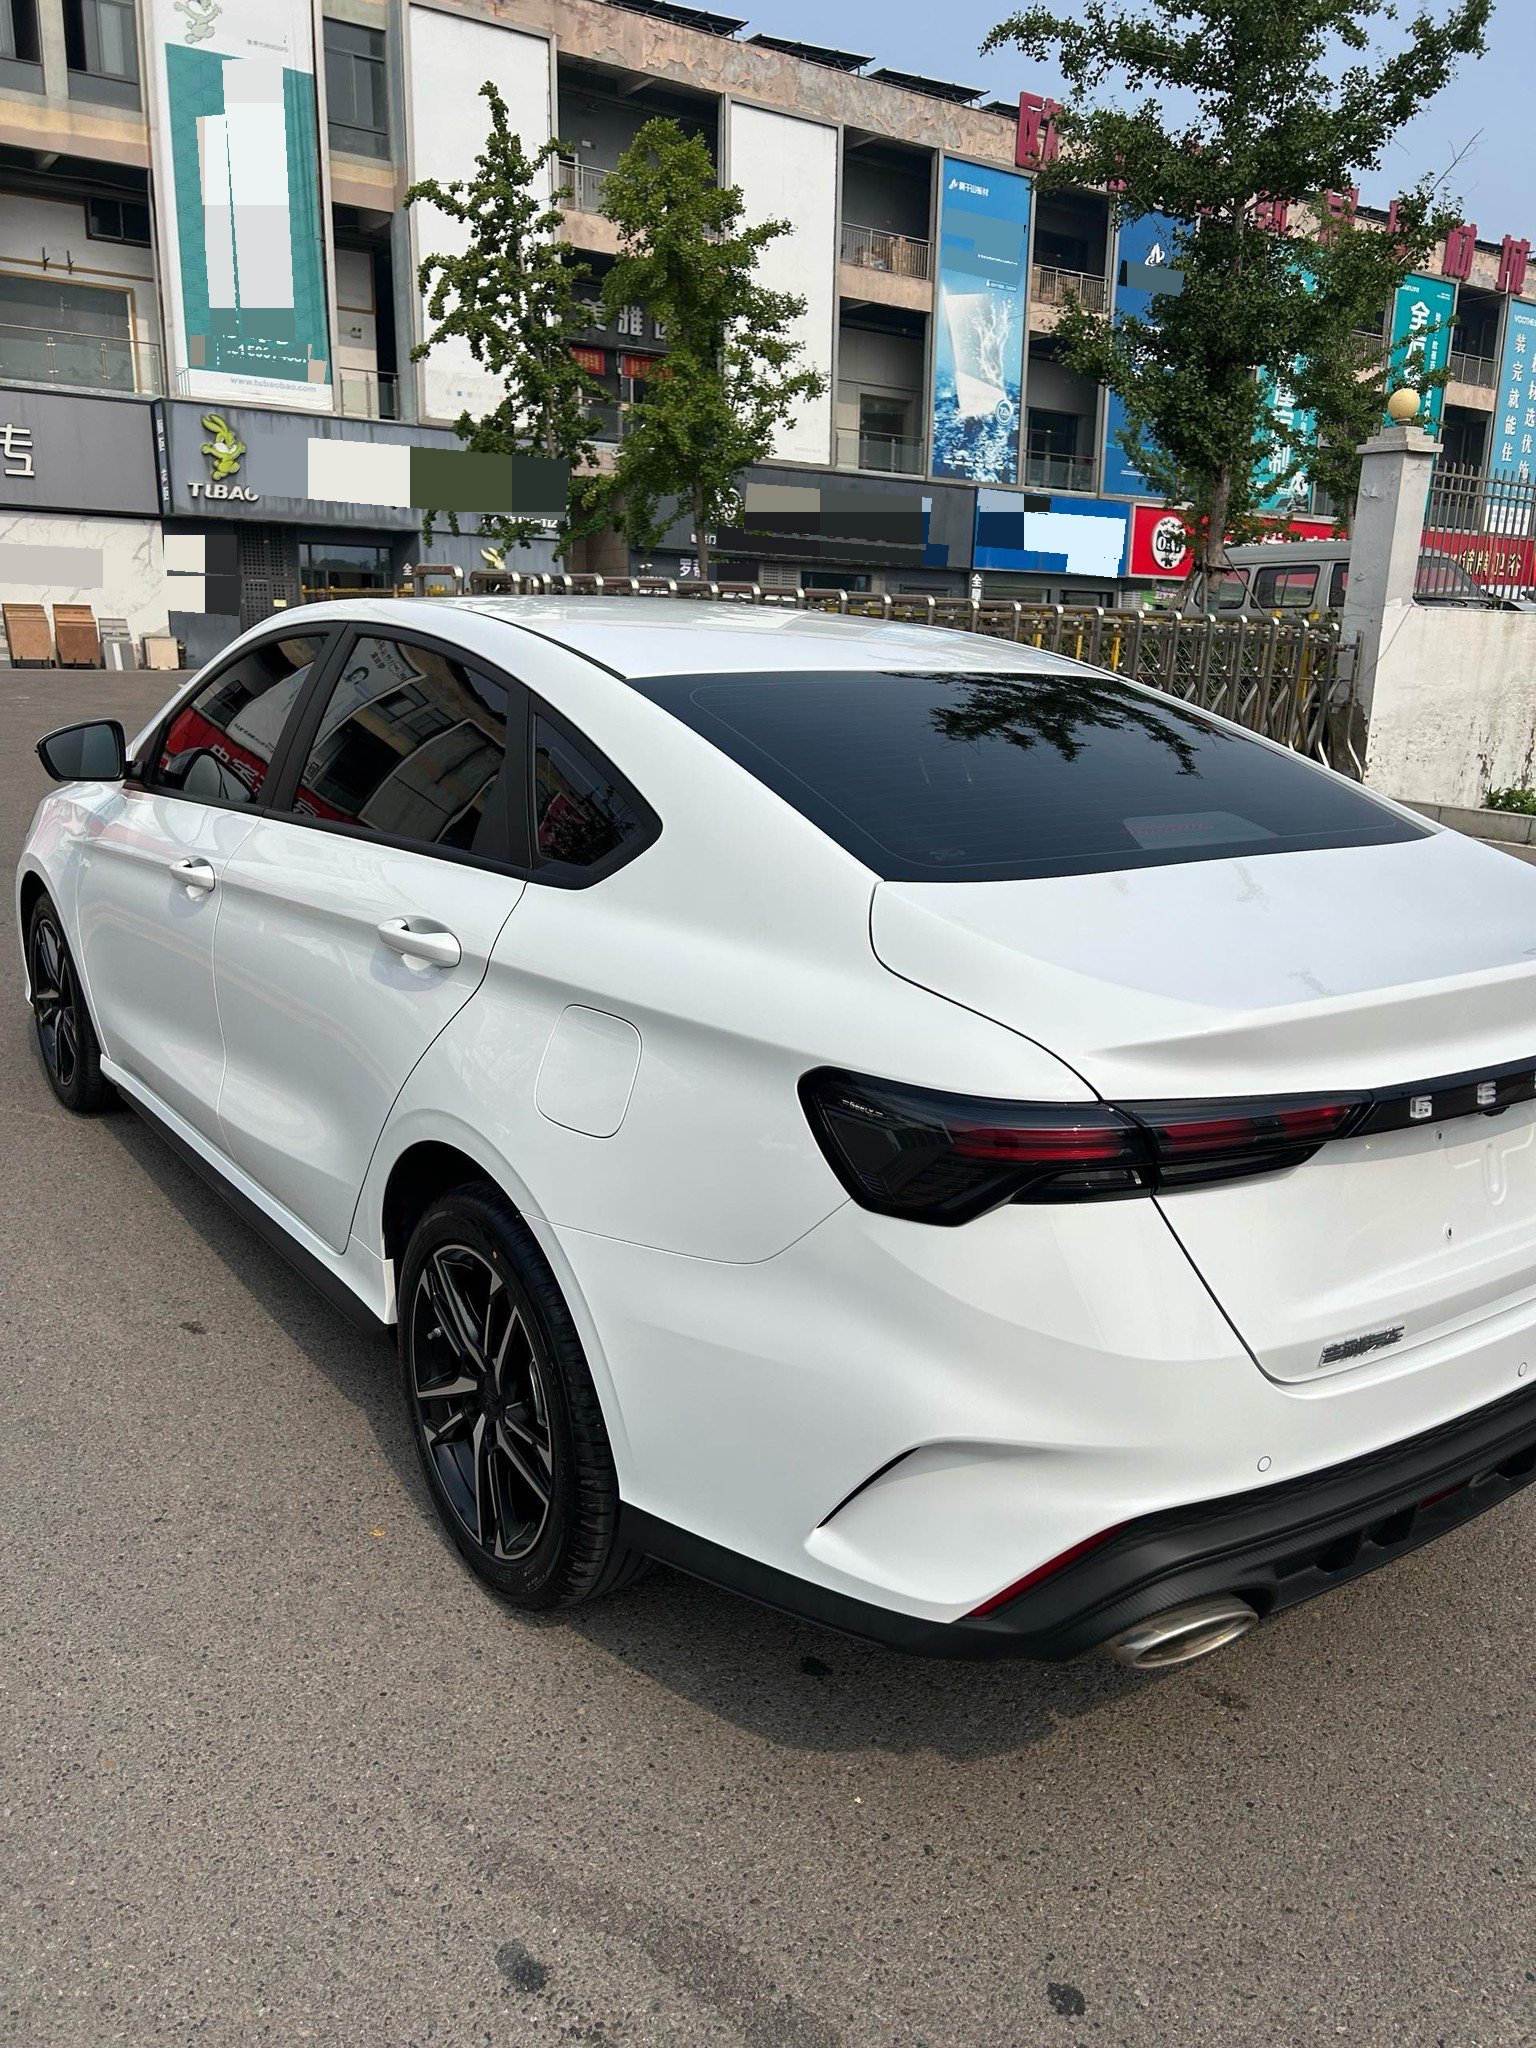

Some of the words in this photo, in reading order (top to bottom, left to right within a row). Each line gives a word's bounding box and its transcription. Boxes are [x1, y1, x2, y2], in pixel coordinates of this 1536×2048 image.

[1502, 333, 1527, 462] 装完就能住
